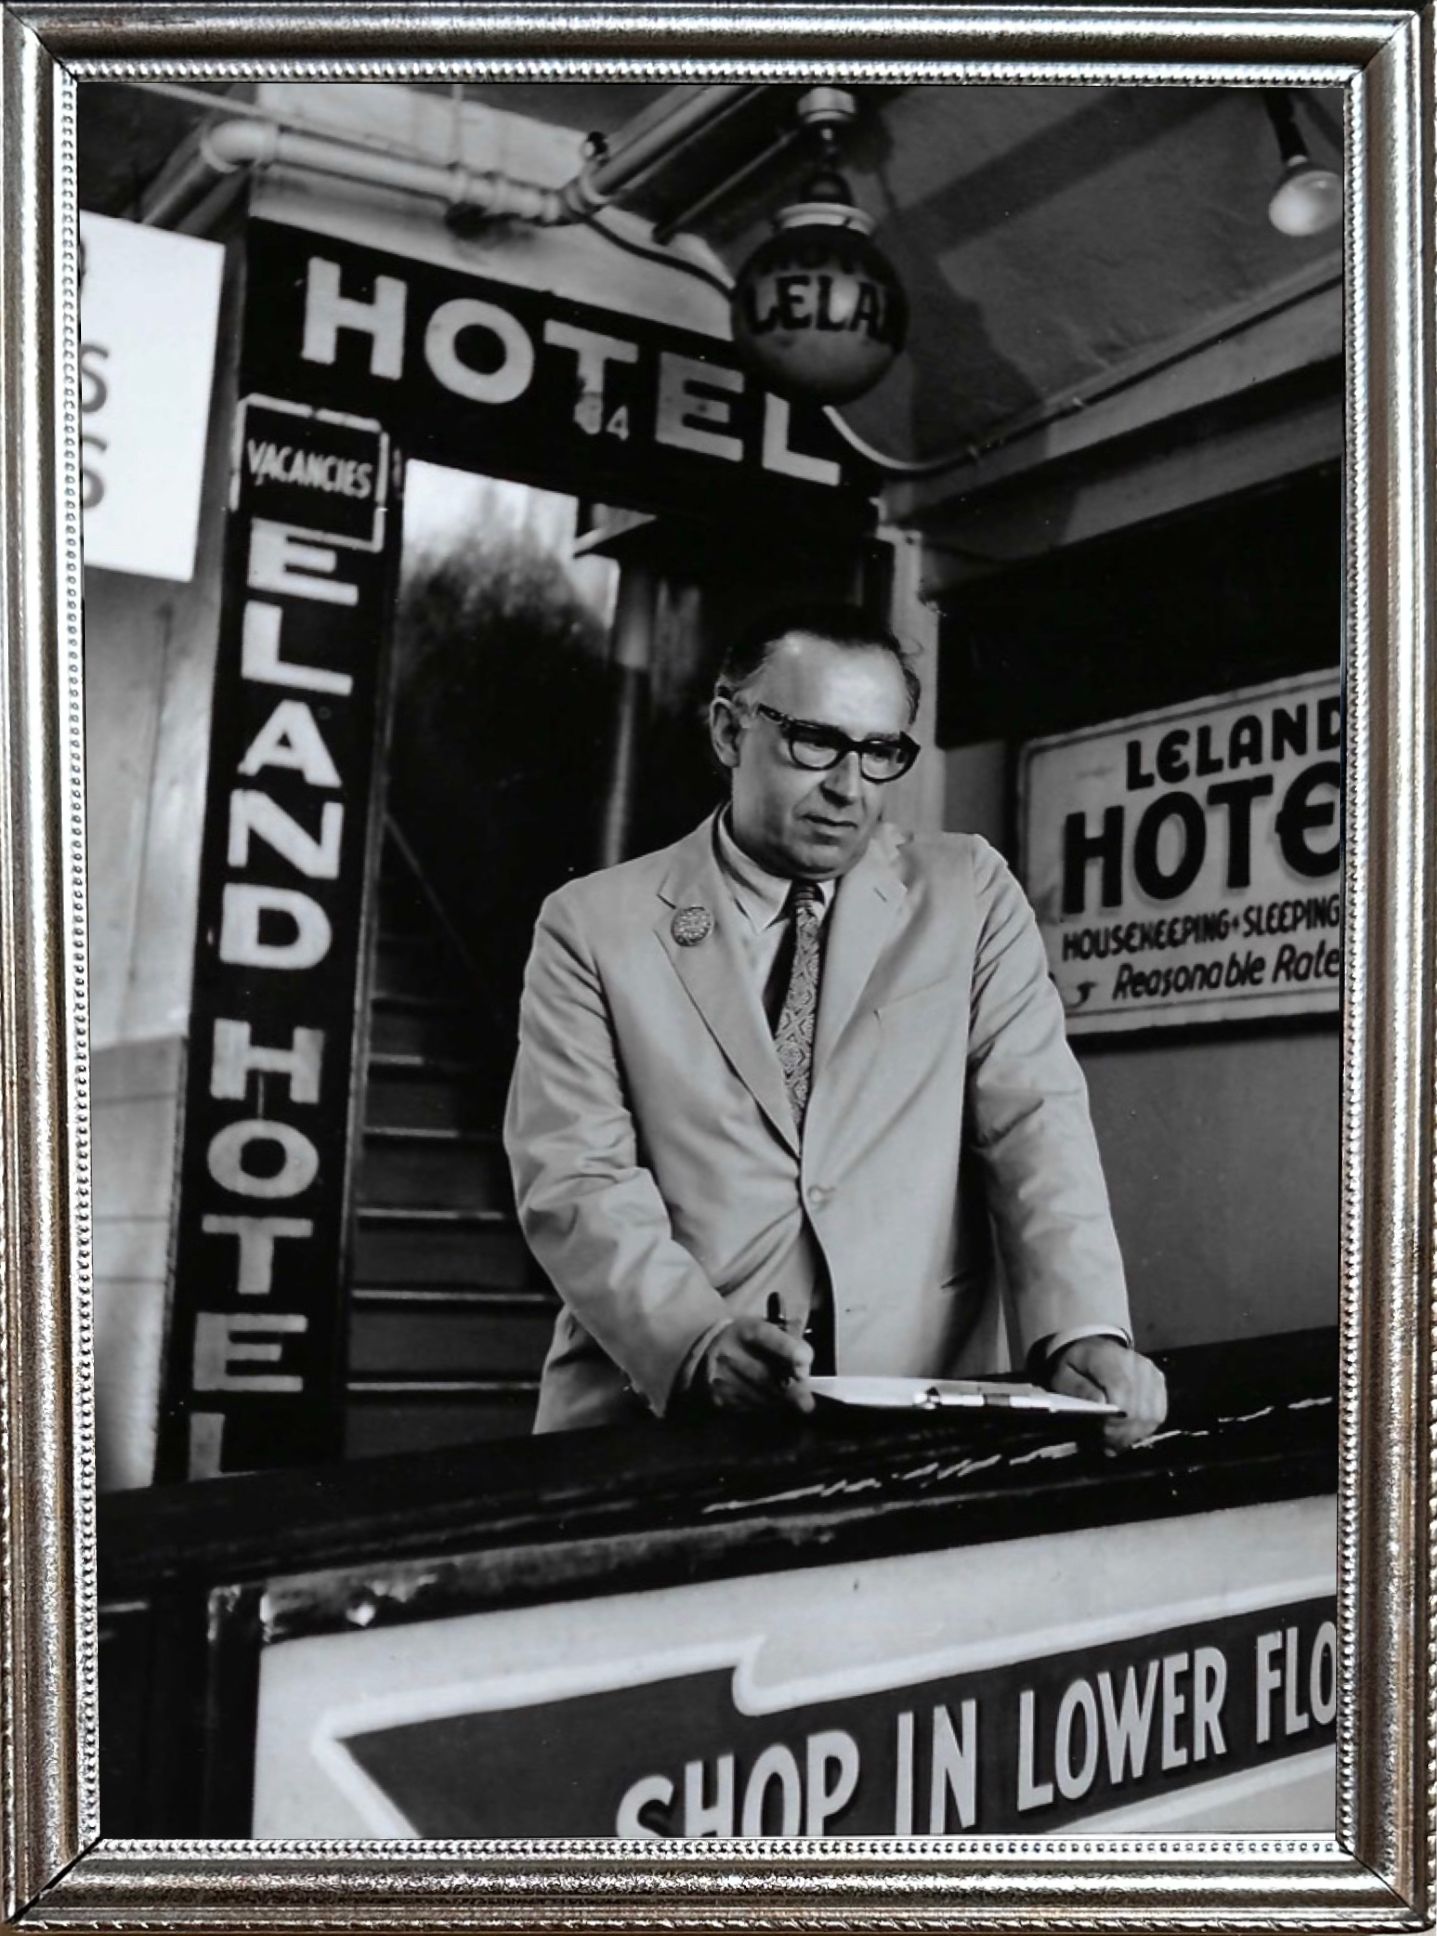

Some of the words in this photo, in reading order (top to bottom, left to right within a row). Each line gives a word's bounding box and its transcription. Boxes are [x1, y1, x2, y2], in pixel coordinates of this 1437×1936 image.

[301, 257, 841, 487] HOTEL
[247, 438, 373, 499] VACANCIES
[1126, 697, 1341, 792] LELAND
[1062, 760, 1341, 914] HOTE
[1063, 908, 1230, 962] HOUSEKEEPING
[1243, 894, 1340, 939] SLEEPING
[1113, 952, 1266, 1001] Reasonable
[1273, 939, 1340, 983] Rate
[615, 1728, 860, 1838] SHOP
[894, 1699, 977, 1837] IN
[1017, 1645, 1228, 1812] LOWER
[1256, 1620, 1337, 1745] FLO
